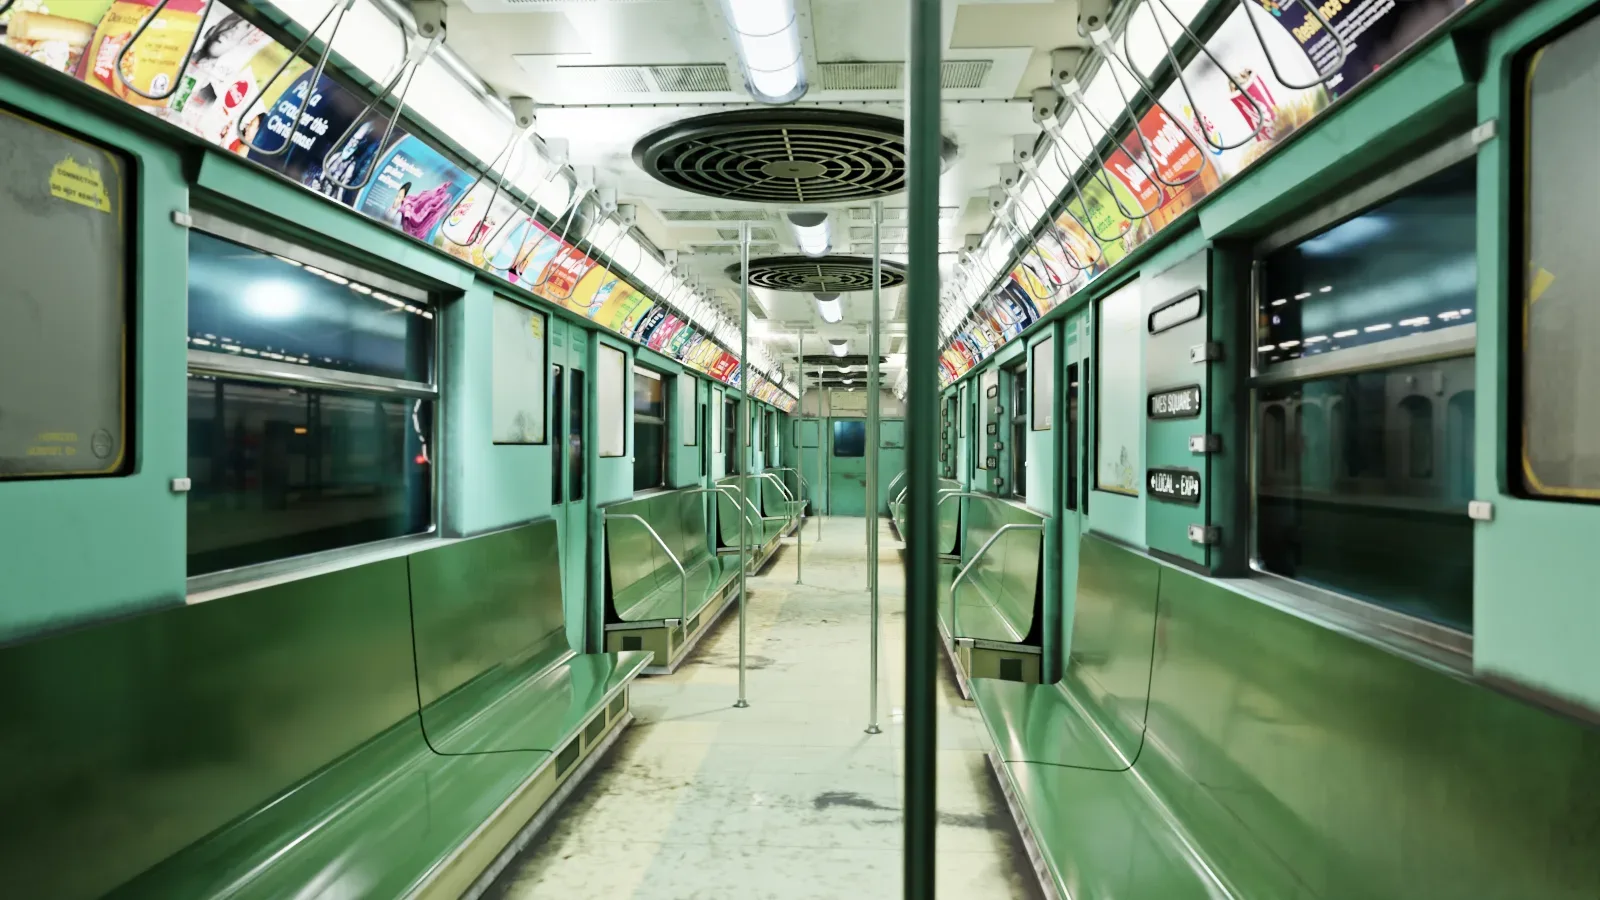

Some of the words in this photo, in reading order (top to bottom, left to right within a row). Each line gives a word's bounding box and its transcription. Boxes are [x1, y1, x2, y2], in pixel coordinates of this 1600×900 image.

[1292, 0, 1342, 44] Resilince
[309, 94, 323, 107] a
[279, 100, 315, 127] cracer
[309, 117, 329, 135] this
[267, 115, 317, 151] Chrismas!
[57, 168, 99, 187] CONNECTION
[1168, 391, 1191, 414] SQUARE
[1155, 472, 1174, 494] LOCAL
